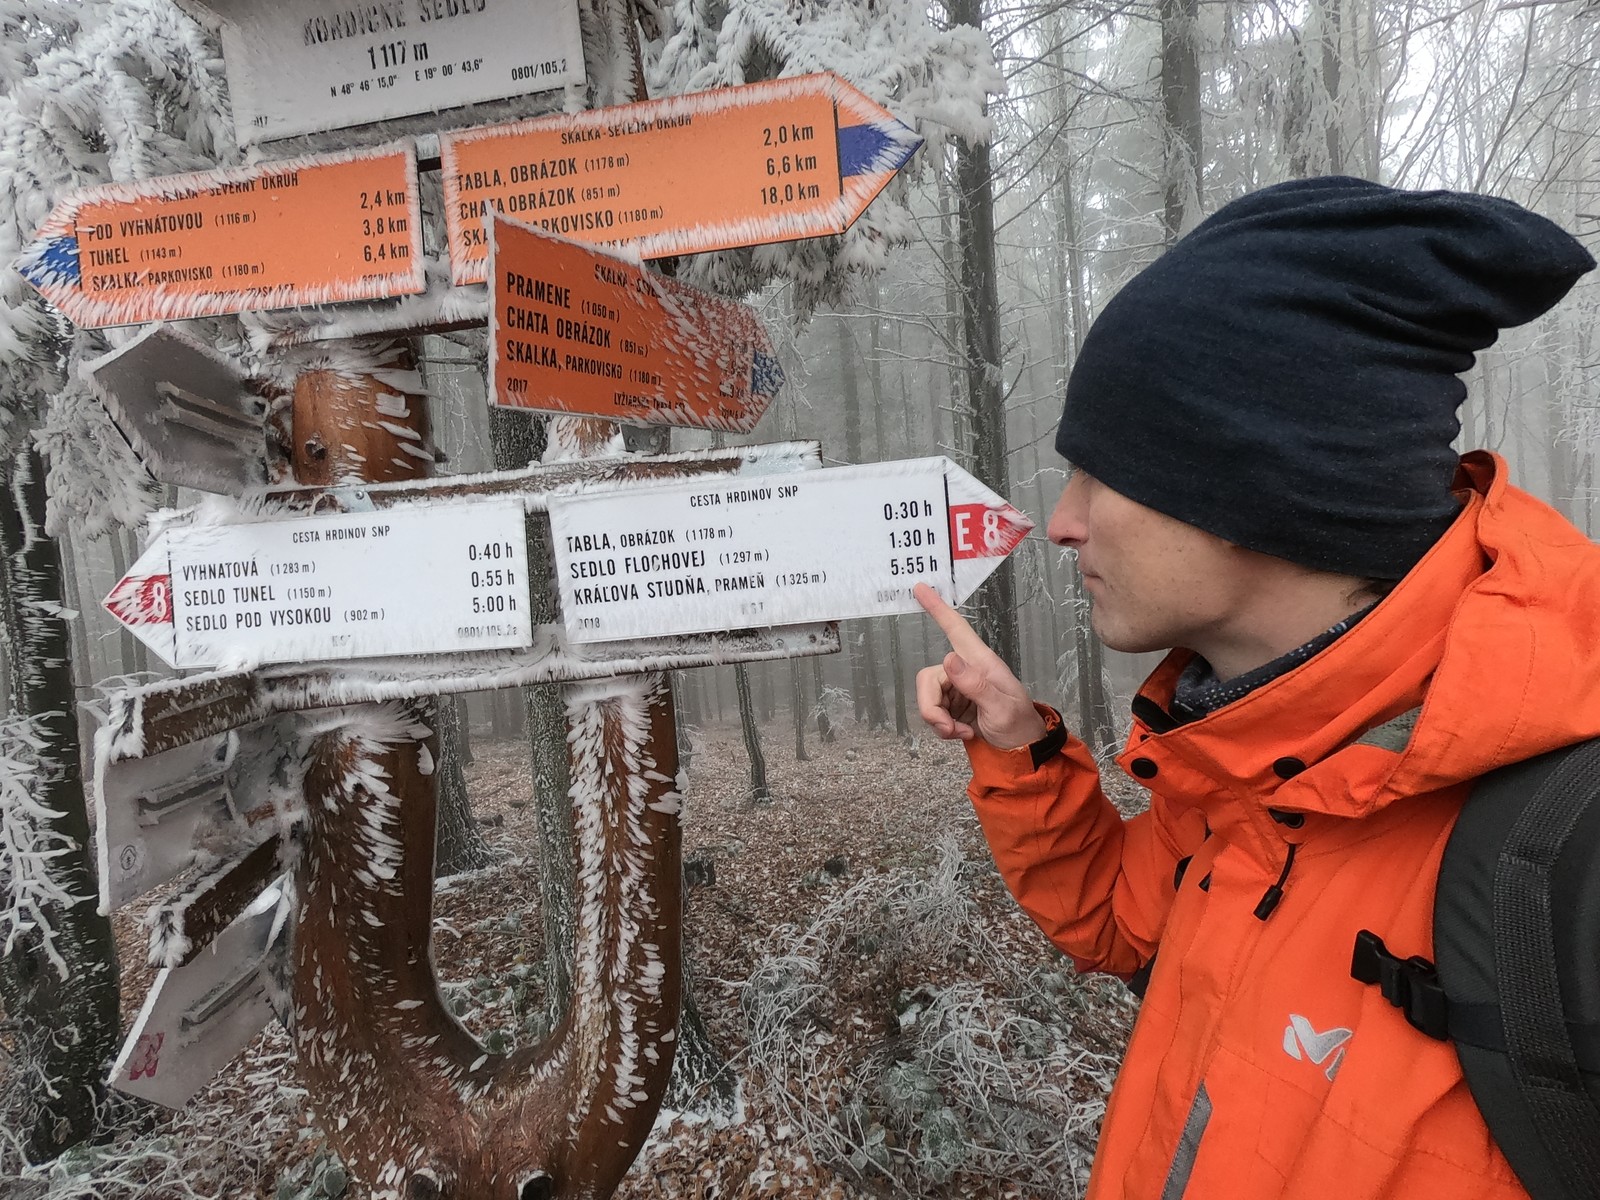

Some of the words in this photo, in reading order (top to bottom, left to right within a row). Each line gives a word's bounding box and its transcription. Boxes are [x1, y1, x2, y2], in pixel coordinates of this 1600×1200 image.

[413, 42, 429, 61] m
[511, 59, 568, 80] 0801/105,2
[330, 86, 337, 97] N
[341, 82, 354, 95] 48°
[415, 70, 421, 82] E
[424, 67, 437, 80] 19°
[561, 127, 601, 145] SKALKA
[763, 126, 787, 148] 2,0
[792, 124, 814, 142] km
[458, 169, 506, 192] TABLA,
[510, 158, 577, 184] OBRÁZOK
[766, 156, 791, 177] 6,6
[795, 154, 817, 172] km
[261, 173, 298, 190] OKRUH
[360, 190, 382, 211] 2,4
[386, 189, 405, 206] km
[509, 187, 575, 213] OBRÁZOK
[761, 184, 793, 205] 18,0
[798, 183, 819, 200] km
[88, 223, 113, 242] POD
[119, 211, 203, 237] VYHNÁTOVOU
[363, 217, 384, 238] 3,8
[388, 217, 407, 233] km
[525, 209, 614, 234] ARKOVISKO
[89, 247, 129, 267] TUNEL
[364, 244, 386, 264] 6,4
[390, 243, 409, 259] km
[148, 266, 212, 285] PARKOVISKO
[594, 263, 628, 288] SKALKA
[507, 271, 570, 309] PRAMENE
[507, 306, 549, 335] CHATA
[556, 318, 611, 348] OBRÁZOK
[507, 340, 561, 372] SKALKA,
[566, 355, 622, 379] PARKOVISKO
[507, 377, 528, 393] 2017
[690, 493, 721, 508] CESTA
[726, 488, 772, 504] HRDINOV
[778, 485, 799, 498] SNP
[884, 501, 919, 521] 0:30
[924, 500, 932, 517] h
[293, 530, 320, 543] CESTA
[325, 527, 366, 541] HRDINOV
[372, 525, 390, 538] SNP
[567, 533, 616, 553] TABLA,
[620, 529, 676, 548] OBRÁZOK
[889, 529, 922, 549] 1:30
[927, 528, 935, 545] h
[956, 513, 973, 551] E
[982, 510, 999, 548] 8
[469, 543, 500, 560] 0:40
[506, 542, 513, 558] h
[570, 559, 616, 579] SEDLO
[625, 550, 706, 574] FLOCHOVEJ
[891, 556, 924, 576] 5:55
[929, 555, 938, 572] h
[471, 570, 502, 587] 0:55
[507, 569, 515, 585] h
[648, 575, 710, 599] STUDŇA,
[715, 571, 766, 593] PRAMEŇ
[184, 588, 225, 607] SEDLO
[233, 585, 275, 603] TUNEL
[473, 595, 504, 613] 5:00
[509, 595, 516, 611] h
[186, 614, 227, 632] SEDLO
[236, 611, 261, 629] POD
[270, 606, 331, 626] VYSOKOU
